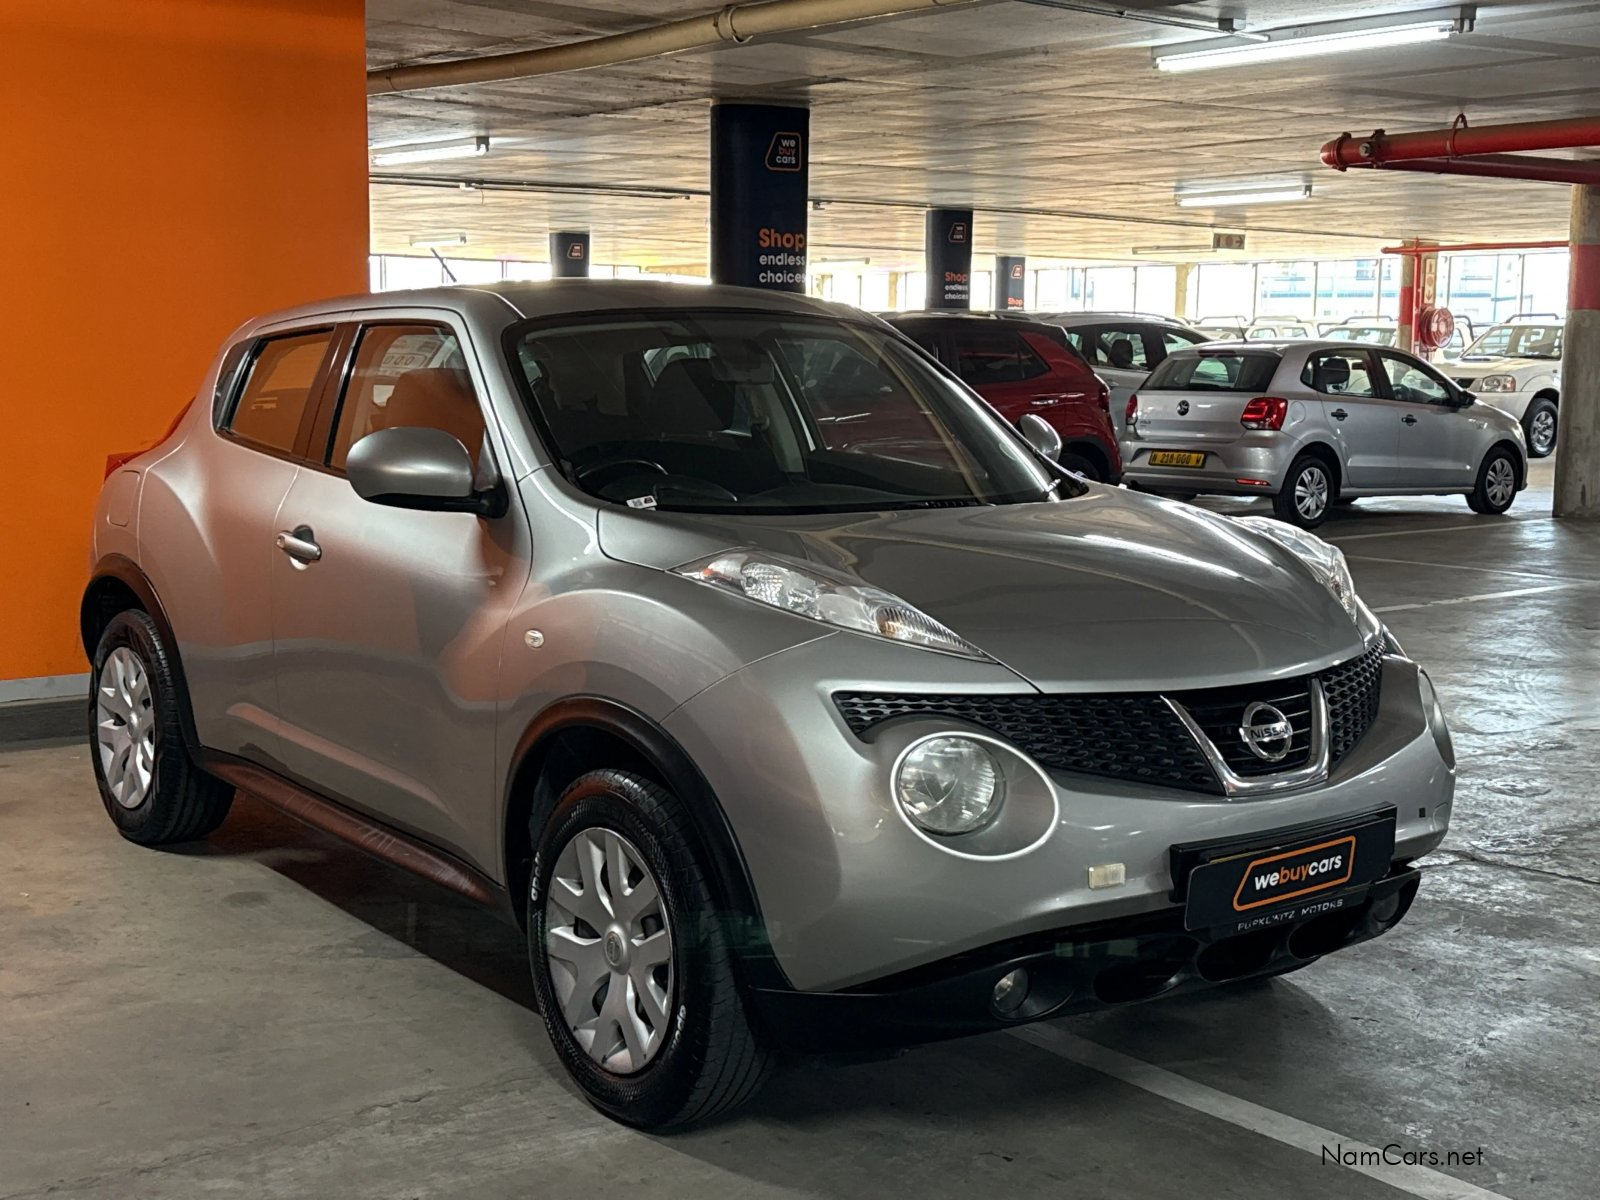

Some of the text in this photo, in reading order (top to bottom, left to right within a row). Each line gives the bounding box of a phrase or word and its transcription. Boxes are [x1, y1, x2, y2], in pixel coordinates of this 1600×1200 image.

[781, 139, 796, 147] we
[778, 146, 796, 156] buy
[775, 155, 796, 164] cars
[759, 228, 805, 252] Shop
[759, 253, 806, 265] endless
[759, 270, 807, 283] choices
[944, 271, 968, 283] Shop
[1249, 725, 1291, 739] NISSAN
[1254, 855, 1342, 890] webuycars
